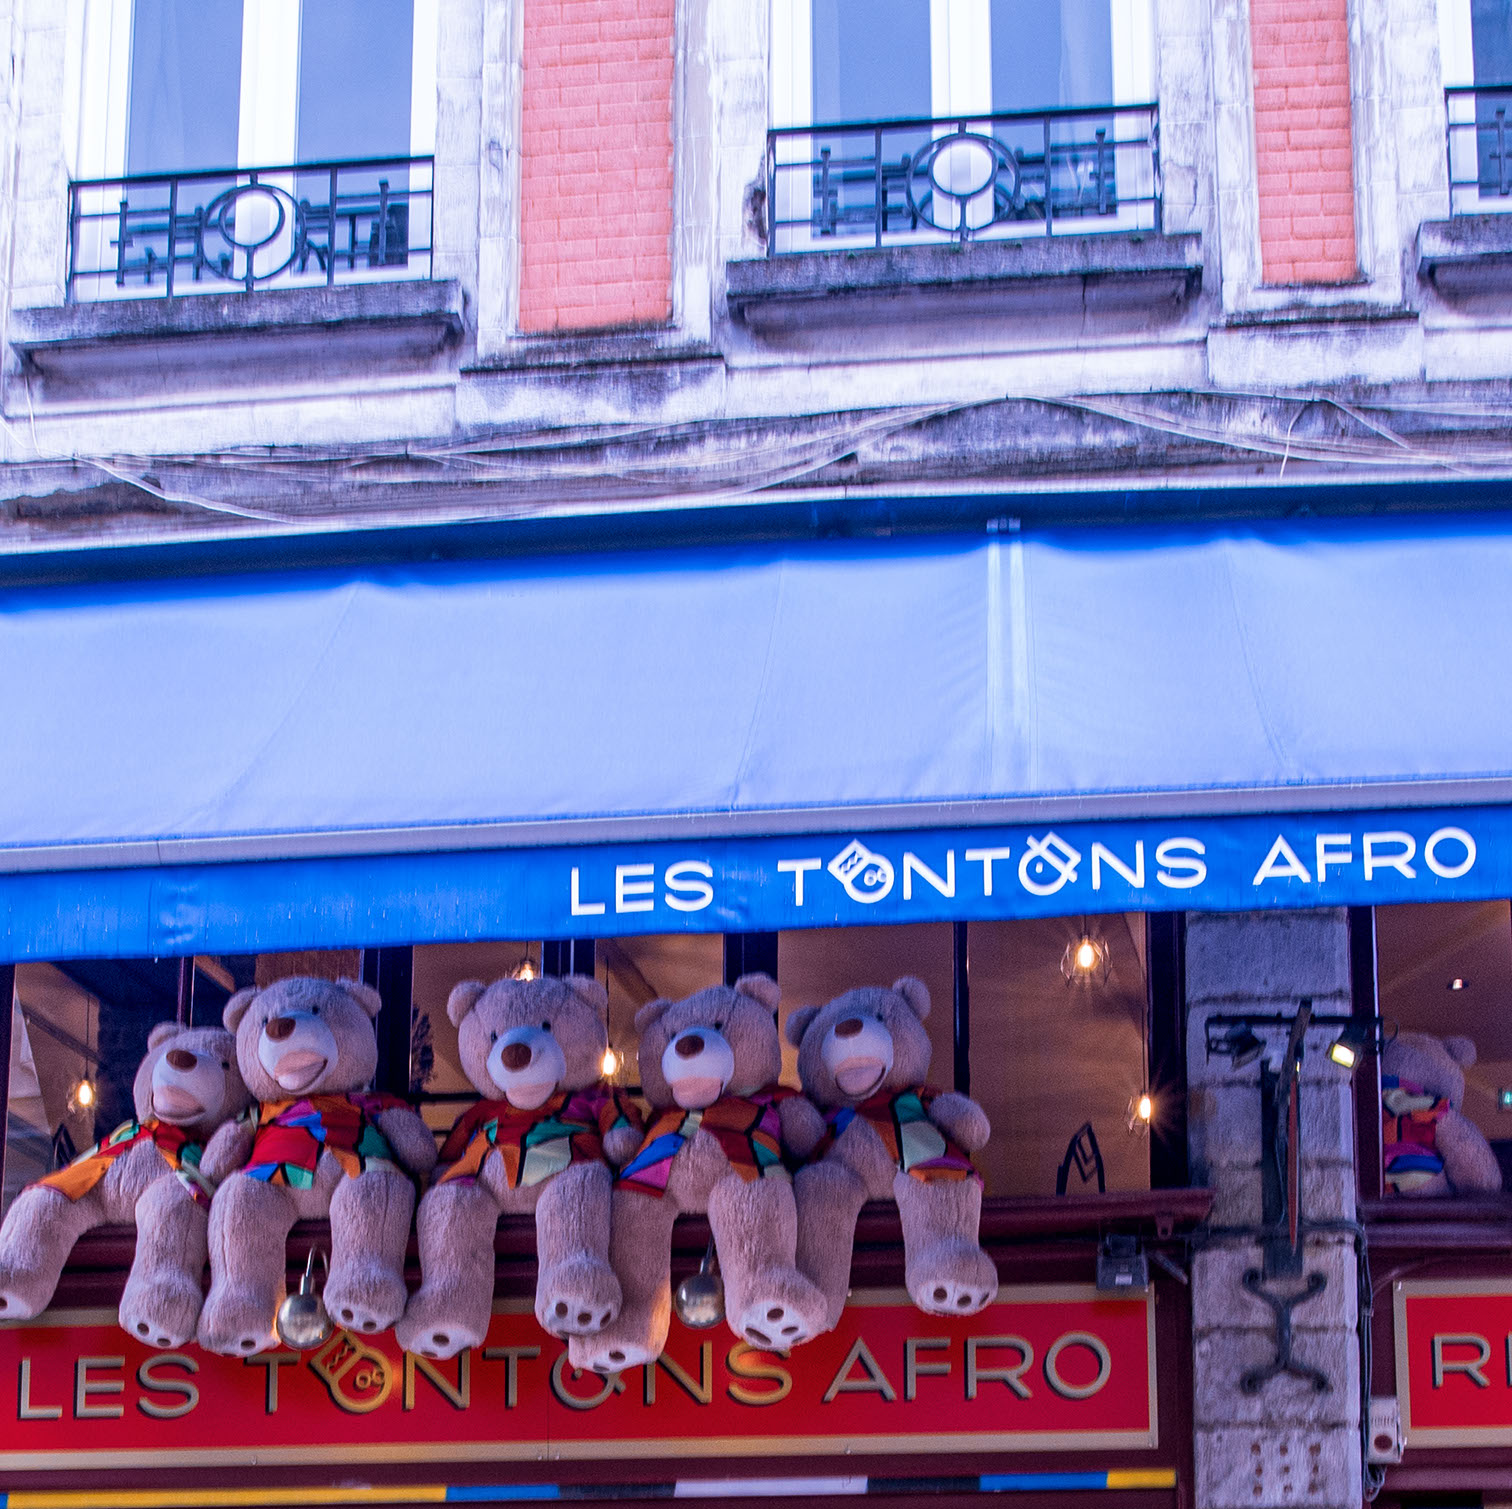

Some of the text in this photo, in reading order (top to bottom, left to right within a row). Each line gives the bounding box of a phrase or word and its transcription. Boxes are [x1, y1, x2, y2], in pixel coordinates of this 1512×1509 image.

[570, 860, 714, 916] LES
[1253, 825, 1477, 886] AFRO
[15, 1350, 199, 1420] LES
[823, 1332, 1112, 1403] AFRO
